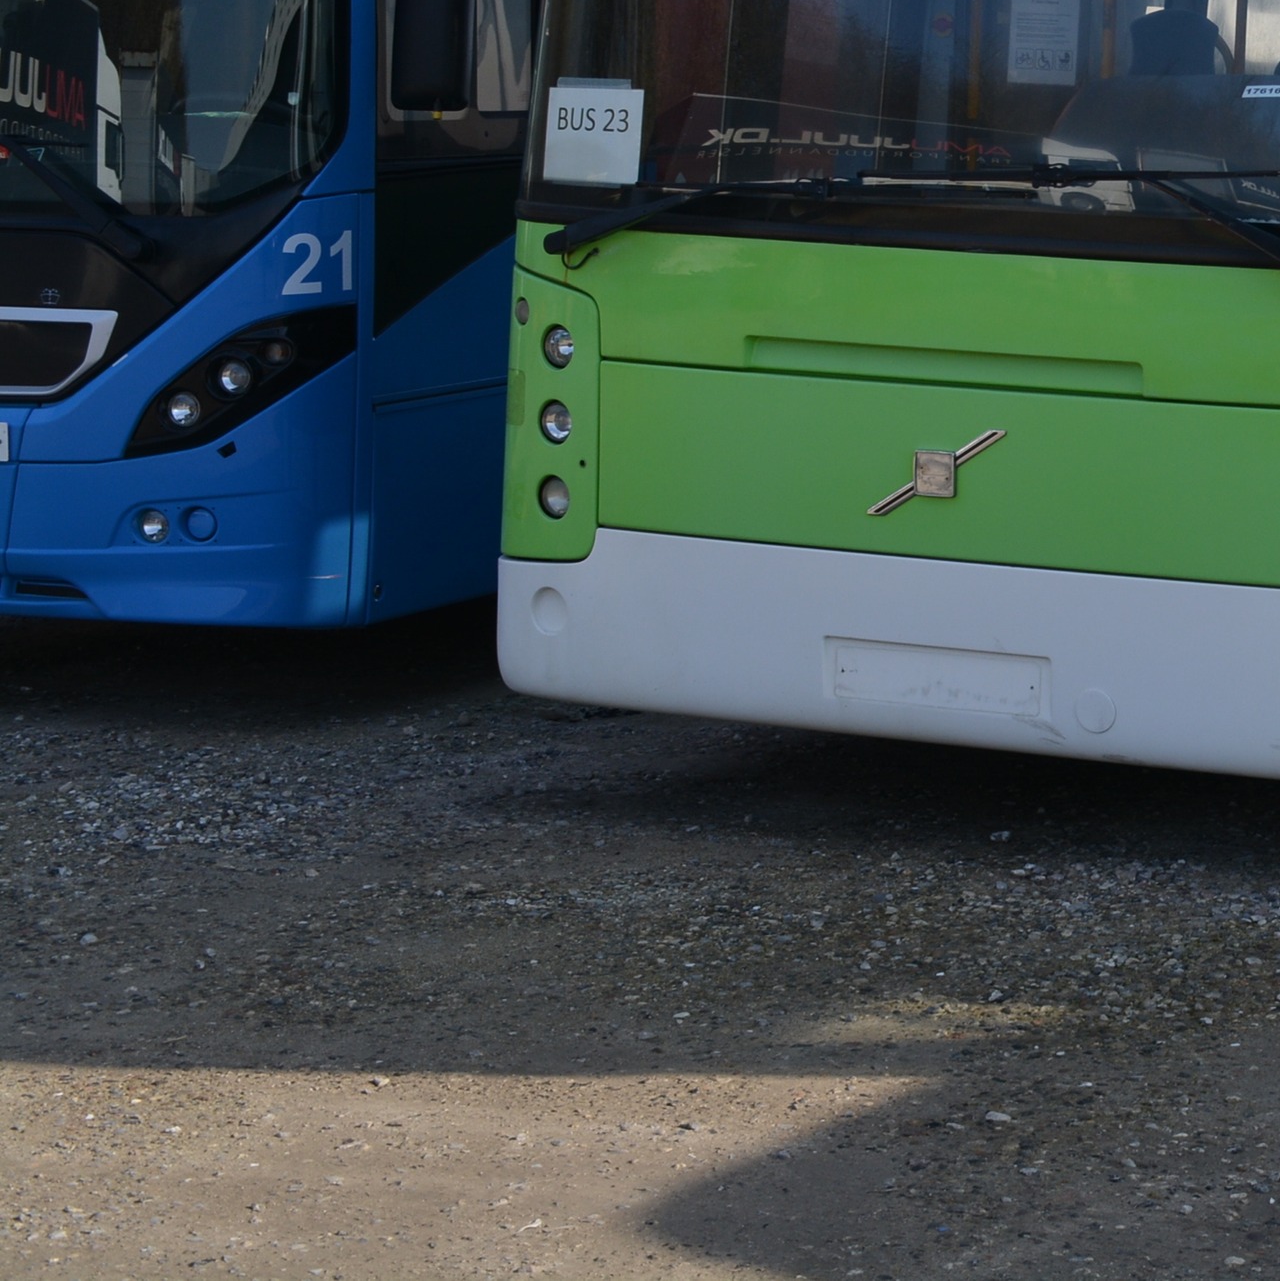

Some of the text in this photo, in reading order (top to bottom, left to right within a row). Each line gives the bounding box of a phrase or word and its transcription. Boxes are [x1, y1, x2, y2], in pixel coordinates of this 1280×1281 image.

[557, 107, 629, 133] BUS 23
[281, 230, 353, 295] 21
